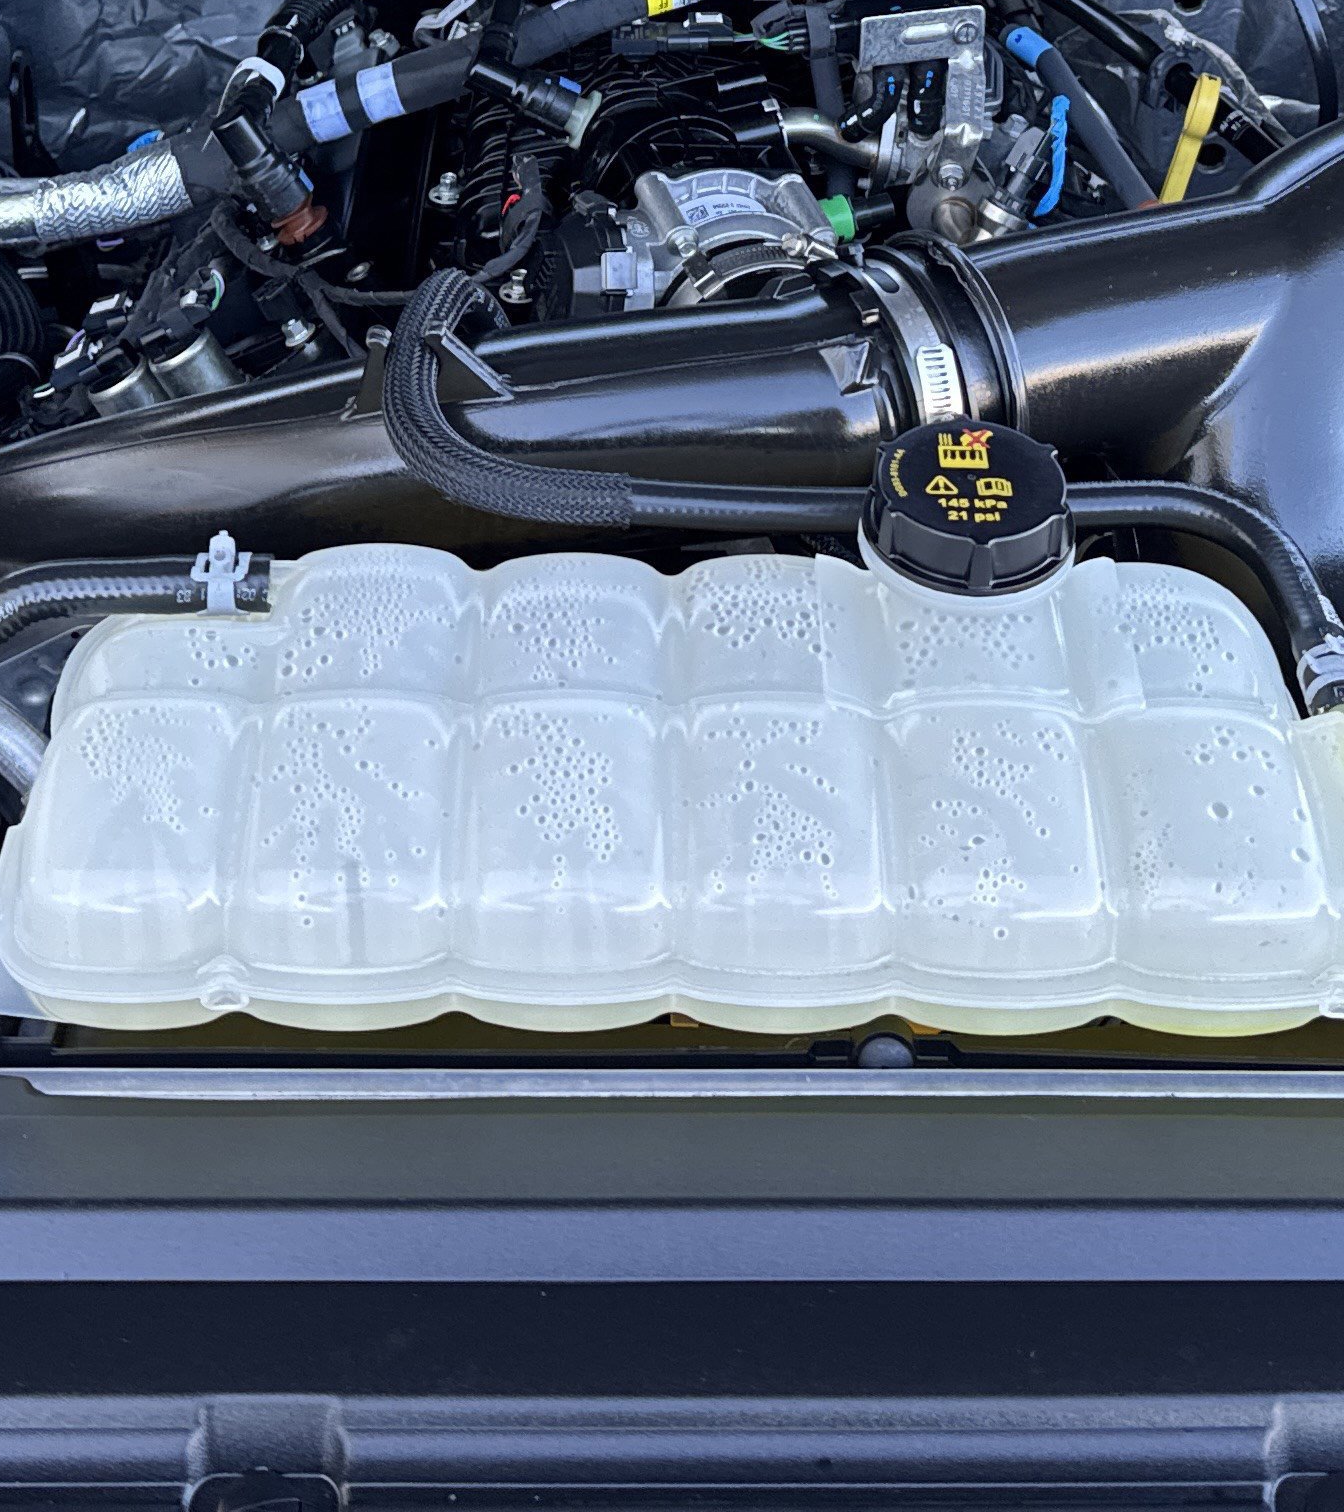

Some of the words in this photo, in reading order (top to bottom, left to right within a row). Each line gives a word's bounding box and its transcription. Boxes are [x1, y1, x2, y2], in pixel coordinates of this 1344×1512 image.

[937, 498, 970, 508] 145
[974, 498, 1008, 509] kPa
[948, 511, 968, 521] 21
[974, 511, 1000, 523] psi
